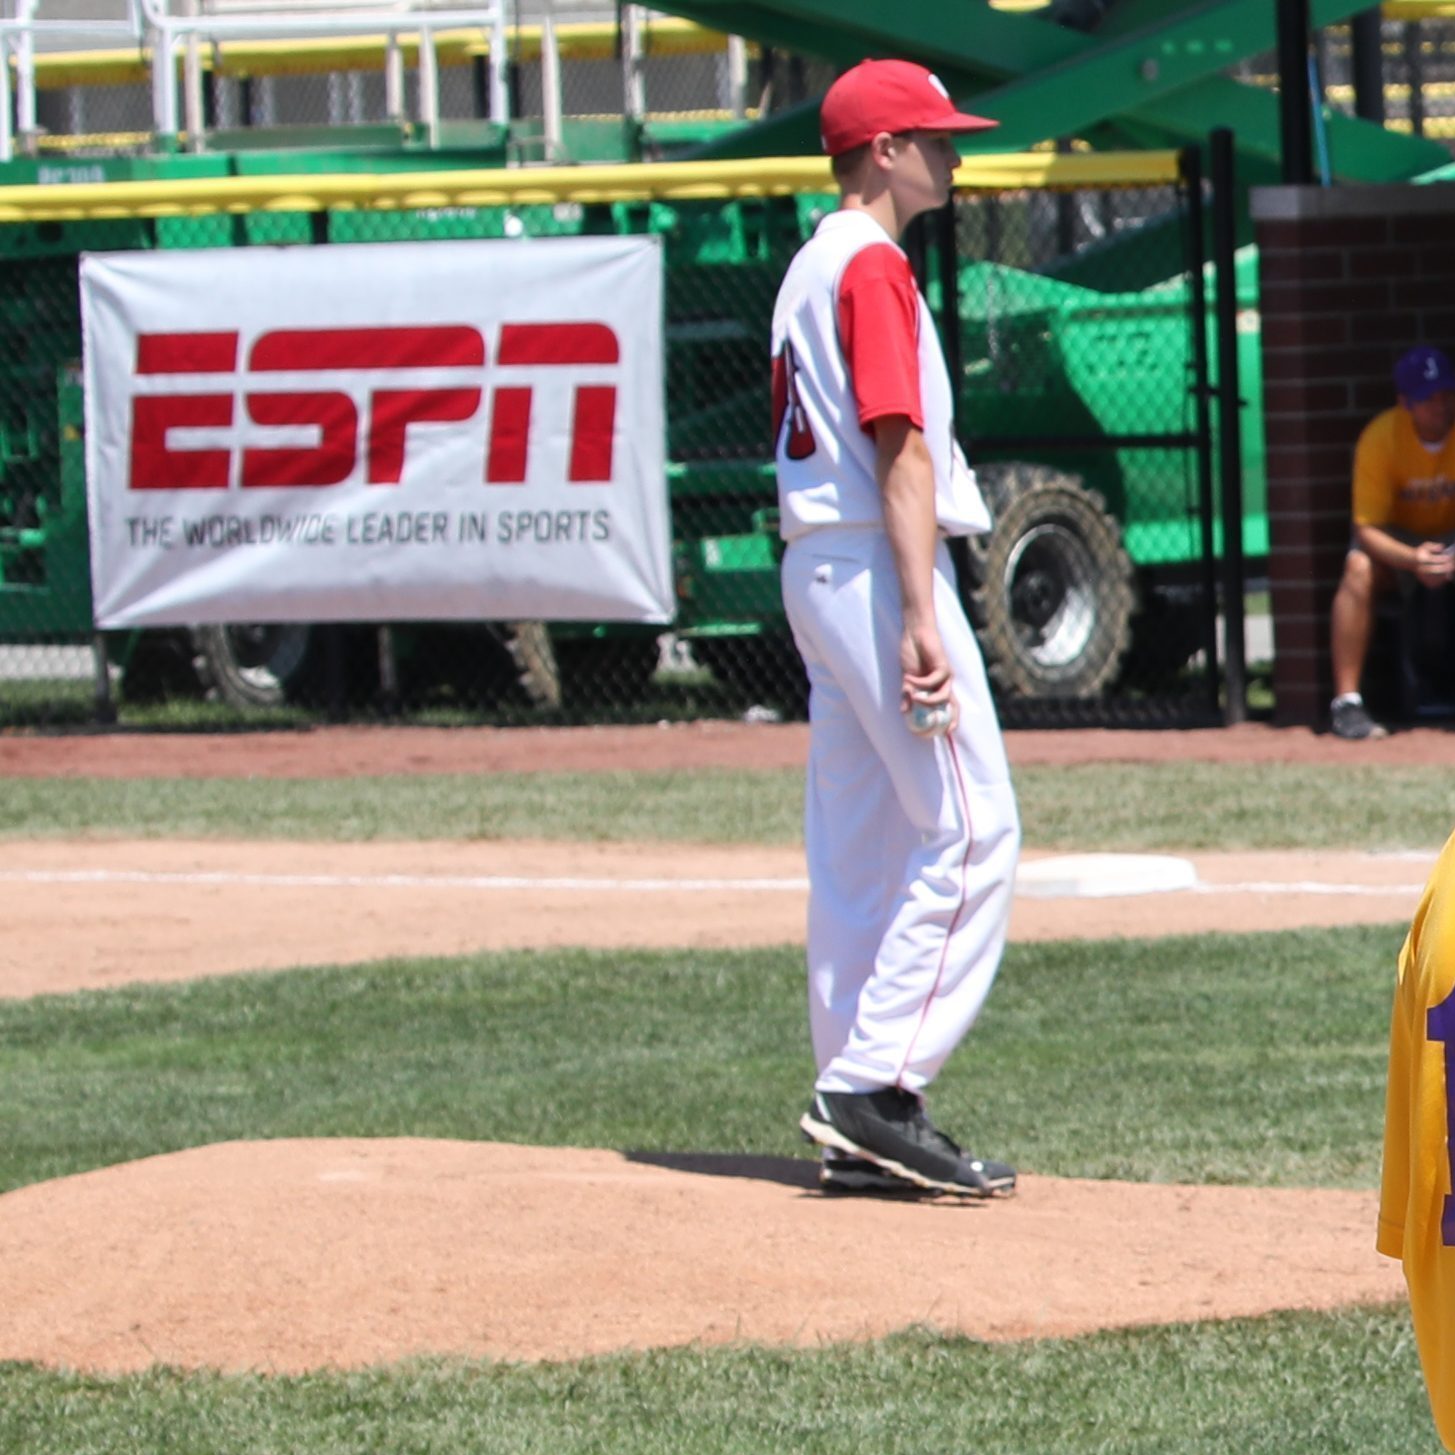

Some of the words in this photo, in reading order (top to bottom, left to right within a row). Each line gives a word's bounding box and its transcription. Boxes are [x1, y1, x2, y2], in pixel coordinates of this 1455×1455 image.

[128, 321, 620, 490] ESPN
[125, 515, 173, 549] THE
[182, 513, 335, 548] WORLDWIDE
[346, 510, 449, 545] LEADER
[459, 511, 486, 543] IN
[497, 508, 611, 544] SPORTS
